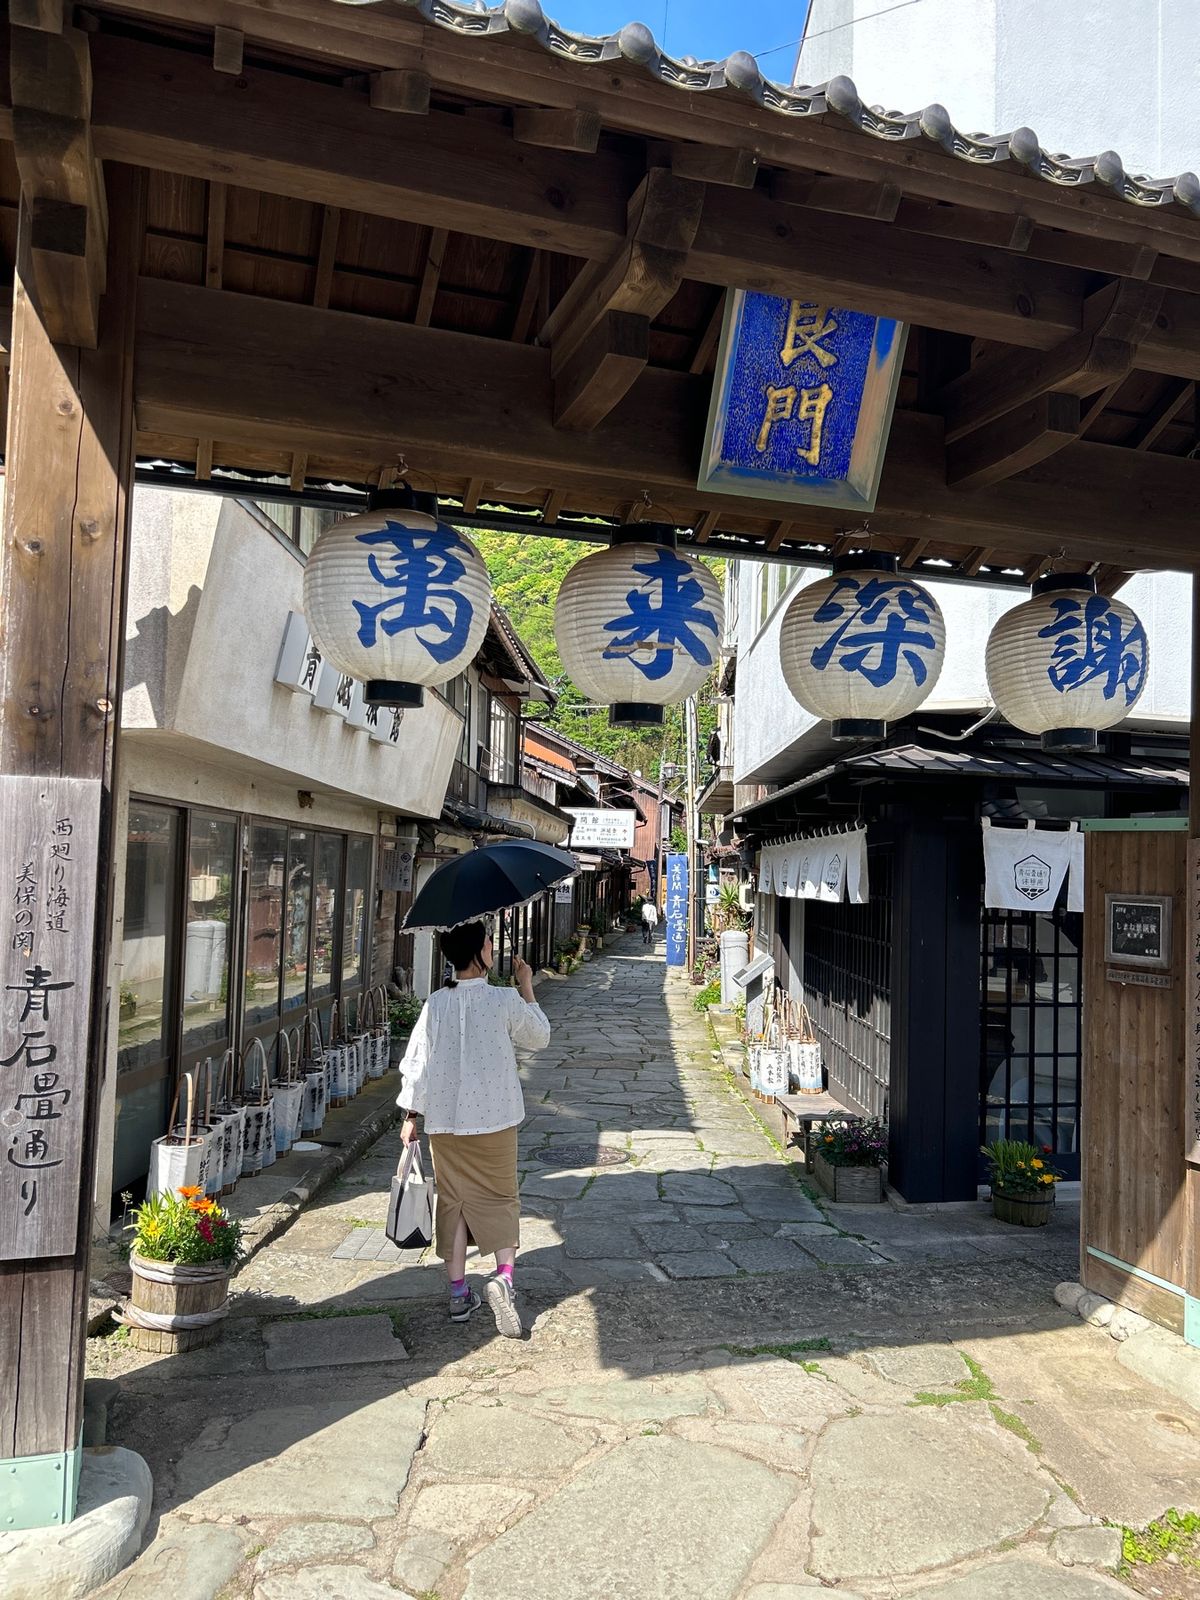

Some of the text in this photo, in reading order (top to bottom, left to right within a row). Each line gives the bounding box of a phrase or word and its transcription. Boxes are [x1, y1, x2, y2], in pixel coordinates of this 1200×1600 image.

[352, 519, 1149, 707] 萬 来 深 謝
[12, 861, 38, 951] 美保の関
[45, 817, 74, 934] 西廻り海道
[0, 965, 75, 1216] 青石畳通り
